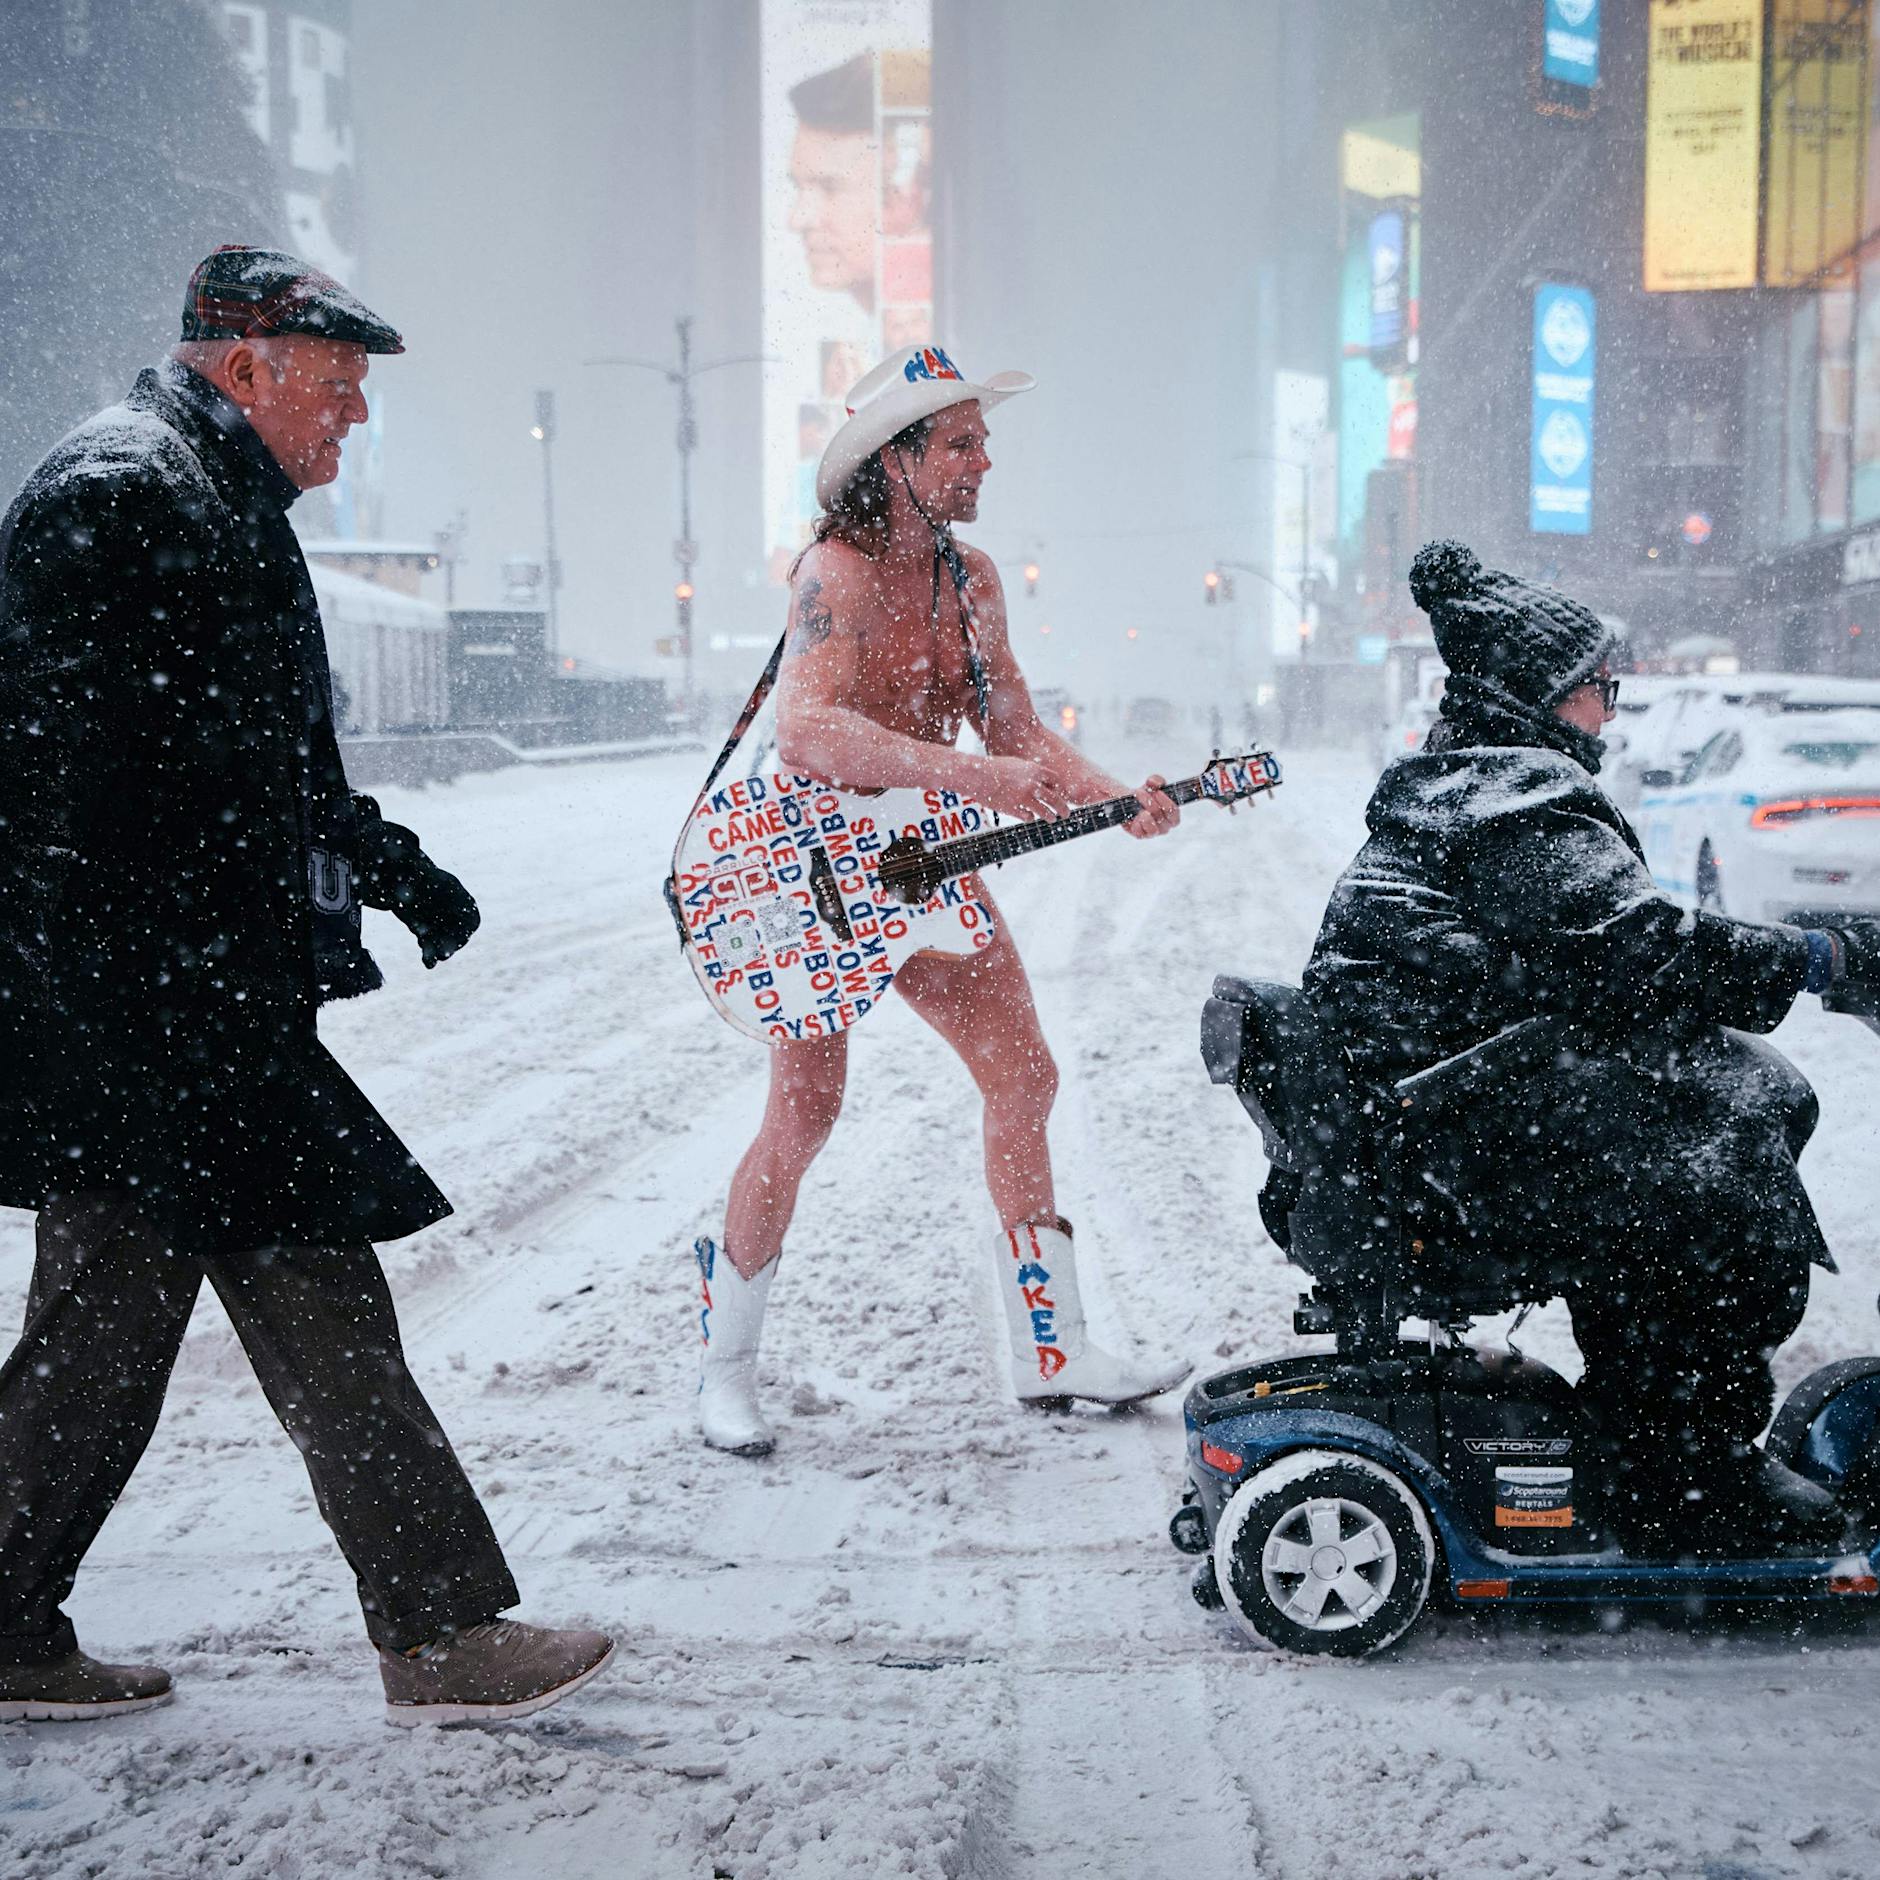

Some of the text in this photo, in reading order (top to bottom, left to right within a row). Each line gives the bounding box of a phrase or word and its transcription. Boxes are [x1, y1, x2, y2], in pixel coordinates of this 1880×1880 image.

[1200, 757, 1280, 796] NAKED
[814, 786, 865, 895] COWBO
[768, 994, 883, 1040] OYSTER
[1470, 1442, 1546, 1452] VICTORY
[1512, 1486, 1569, 1496] Scootaround
[1515, 1500, 1553, 1508] RENTALS
